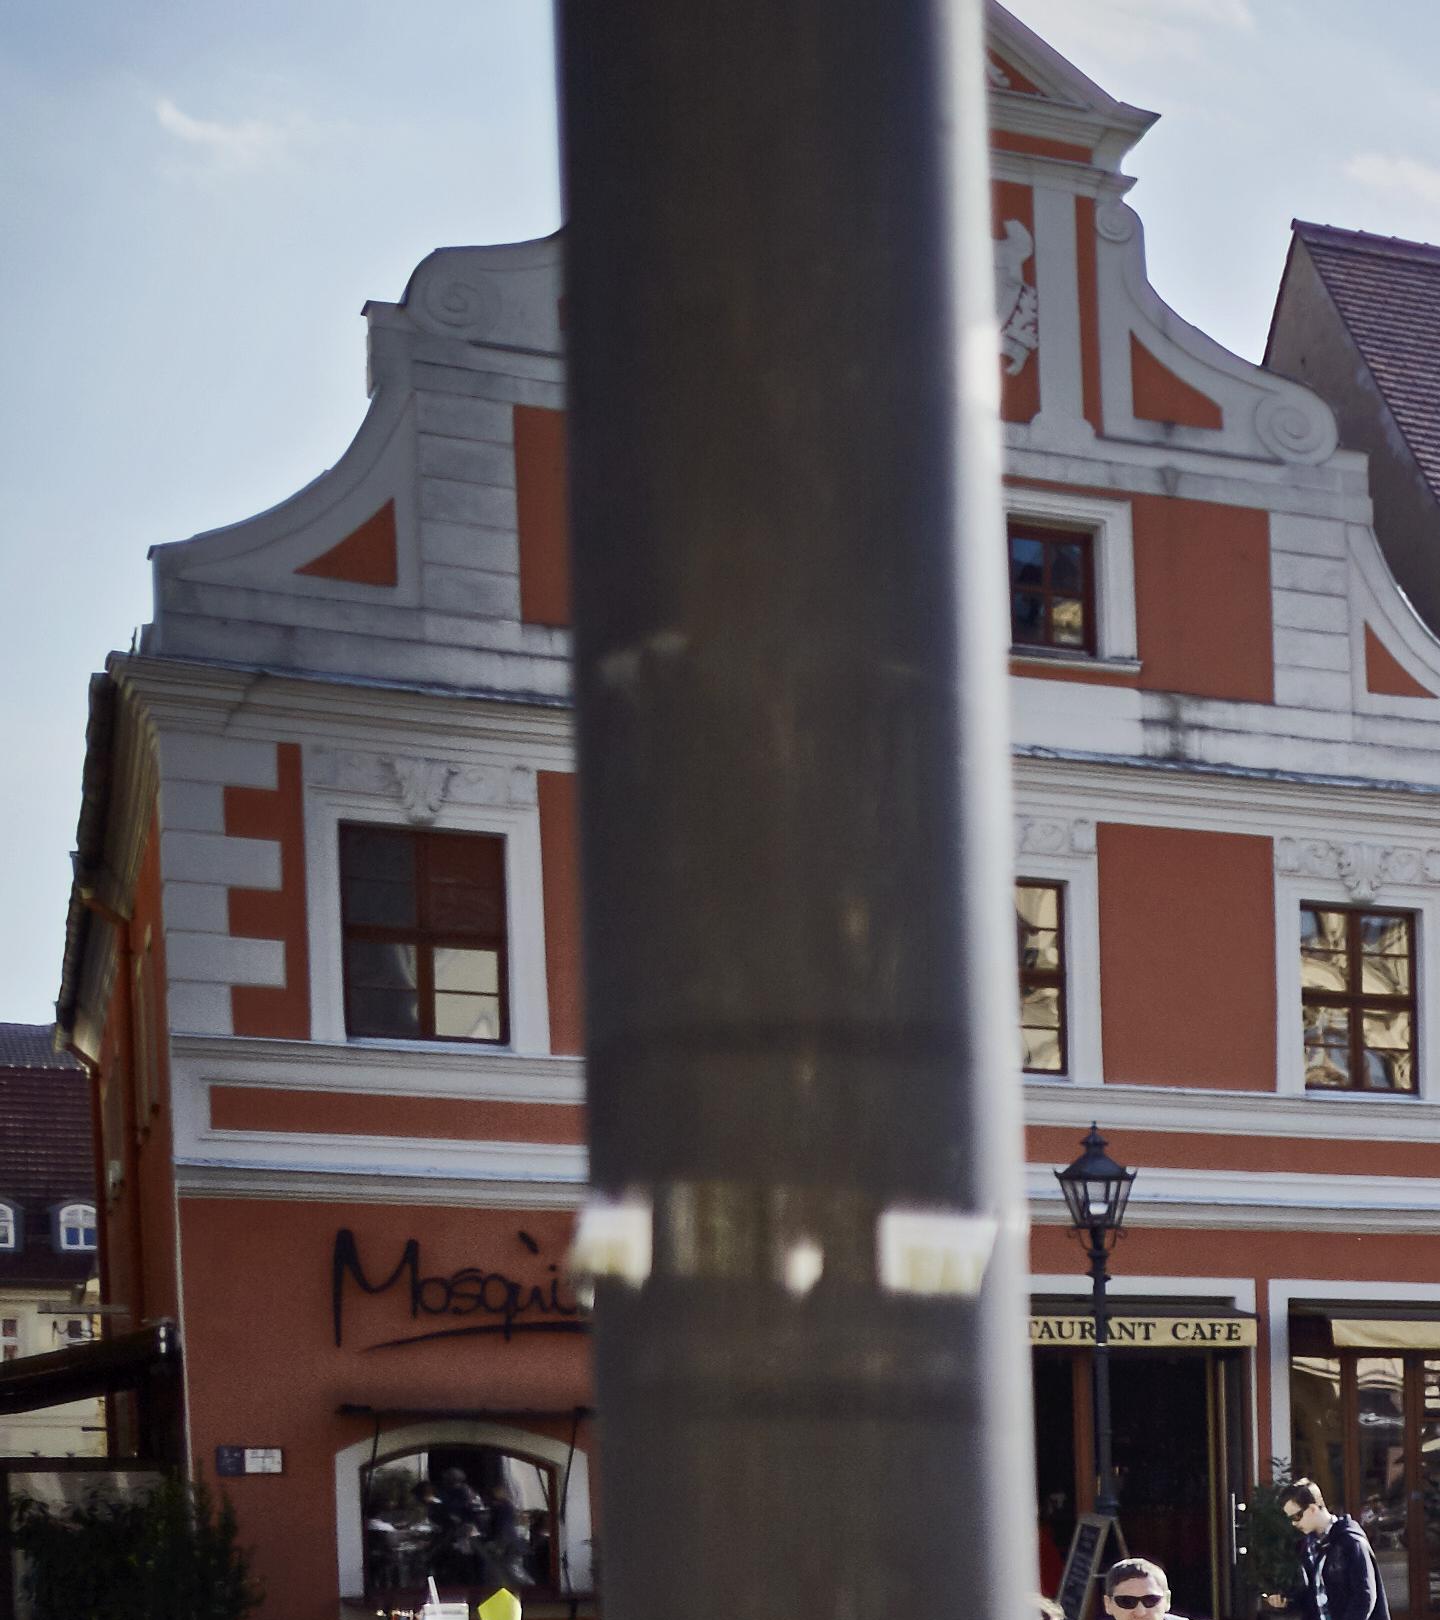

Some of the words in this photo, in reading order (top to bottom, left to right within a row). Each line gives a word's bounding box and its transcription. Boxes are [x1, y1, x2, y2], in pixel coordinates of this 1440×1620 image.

[333, 1228, 583, 1348] Mosqui
[1028, 1320, 1157, 1341] TAURANT
[1171, 1321, 1242, 1342] CAFE
